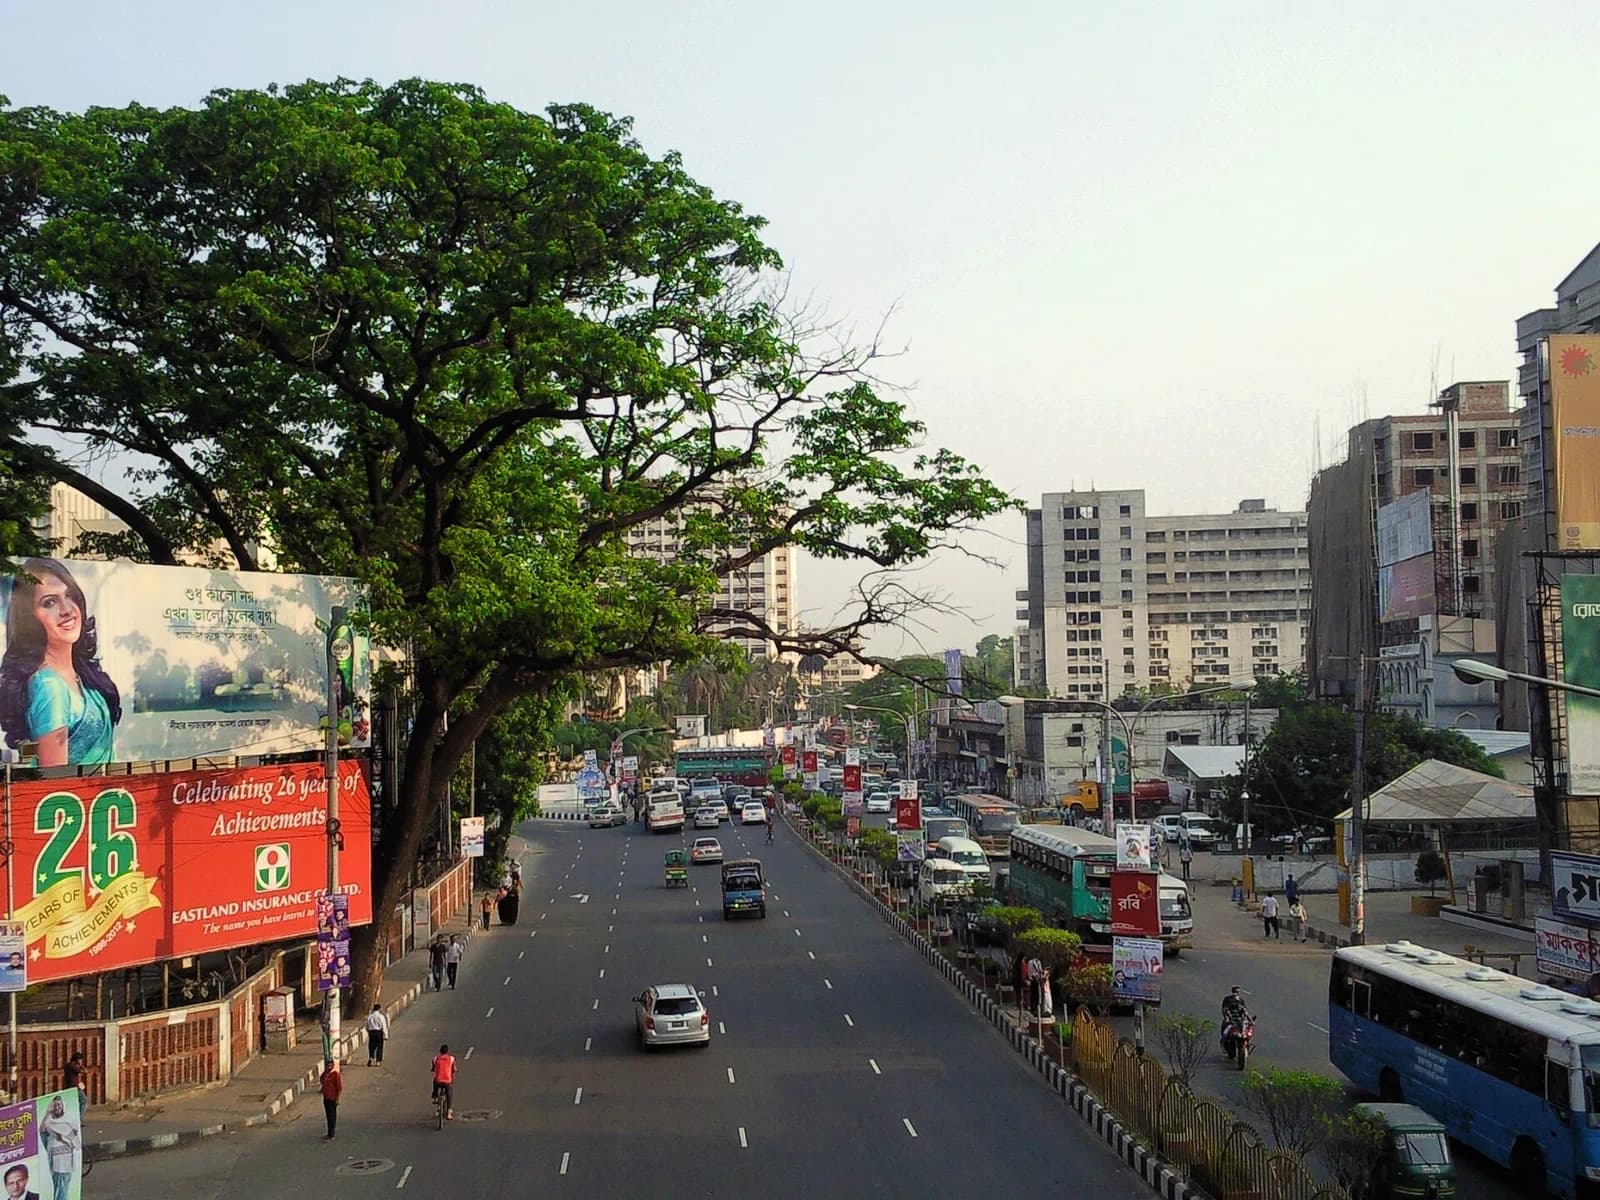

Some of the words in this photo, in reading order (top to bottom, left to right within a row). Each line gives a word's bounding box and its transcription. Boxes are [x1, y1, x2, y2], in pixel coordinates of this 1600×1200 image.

[205, 588, 236, 603] কালো
[163, 606, 188, 621] এখন
[192, 608, 223, 623] ভালো
[172, 776, 274, 805] Celebrating
[277, 774, 295, 797] 26
[299, 776, 340, 800] yeas
[344, 769, 361, 796] of
[211, 806, 327, 836] Achievements
[33, 788, 137, 898] 26
[62, 889, 81, 904] OF
[172, 902, 239, 924] EASTLAND
[242, 891, 312, 912] INSURANCE
[1117, 893, 1140, 911] রবি
[52, 881, 138, 949] ACHIEVEMENTS
[203, 923, 220, 935] The
[223, 921, 246, 932] name
[246, 919, 262, 930] you
[262, 914, 281, 925] have
